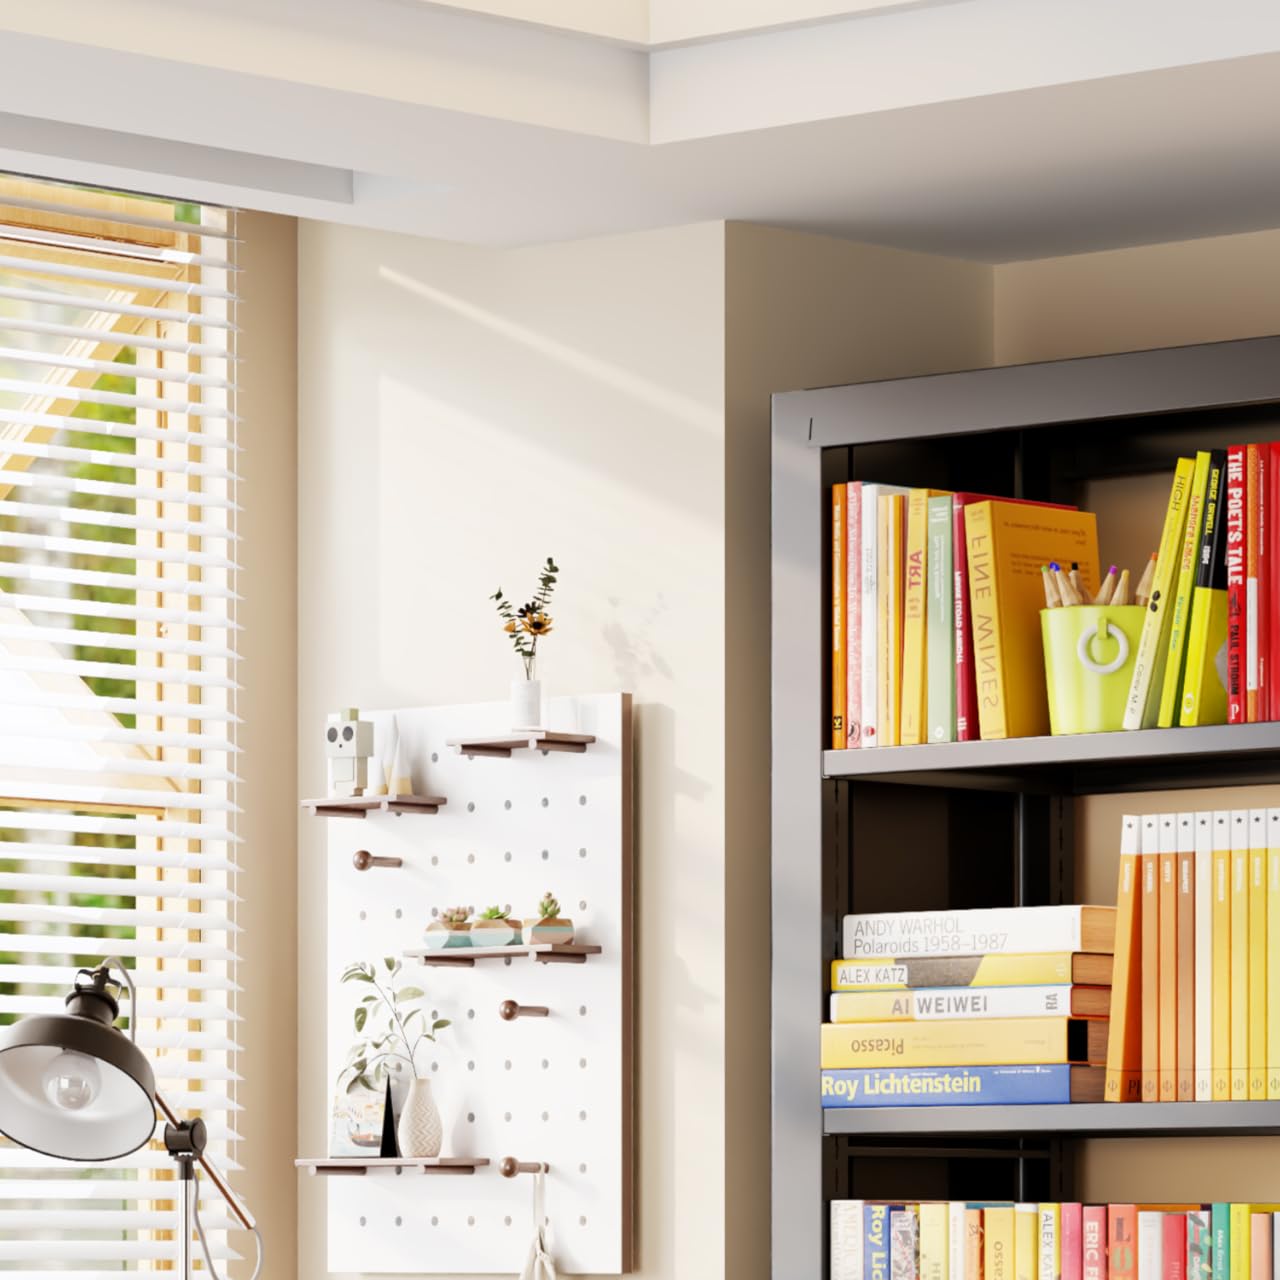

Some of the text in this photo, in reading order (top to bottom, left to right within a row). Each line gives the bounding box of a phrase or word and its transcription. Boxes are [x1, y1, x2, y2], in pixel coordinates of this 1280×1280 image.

[1171, 475, 1186, 512] HIGH
[1227, 451, 1243, 586] THE POET'S TALE
[1231, 624, 1240, 696] PAUL STROHM
[854, 916, 964, 937] ANDY WARHOL
[853, 934, 919, 955] Polaroids
[839, 967, 905, 985] ALEX KATZ
[892, 995, 988, 1014] AI WEIWEI
[851, 1038, 905, 1056] Picasso
[821, 1071, 982, 1100] Roy Lichtenstein
[868, 1204, 886, 1246] Roy
[1043, 1213, 1053, 1249] ALEX
[1086, 1220, 1099, 1260] ERIC
